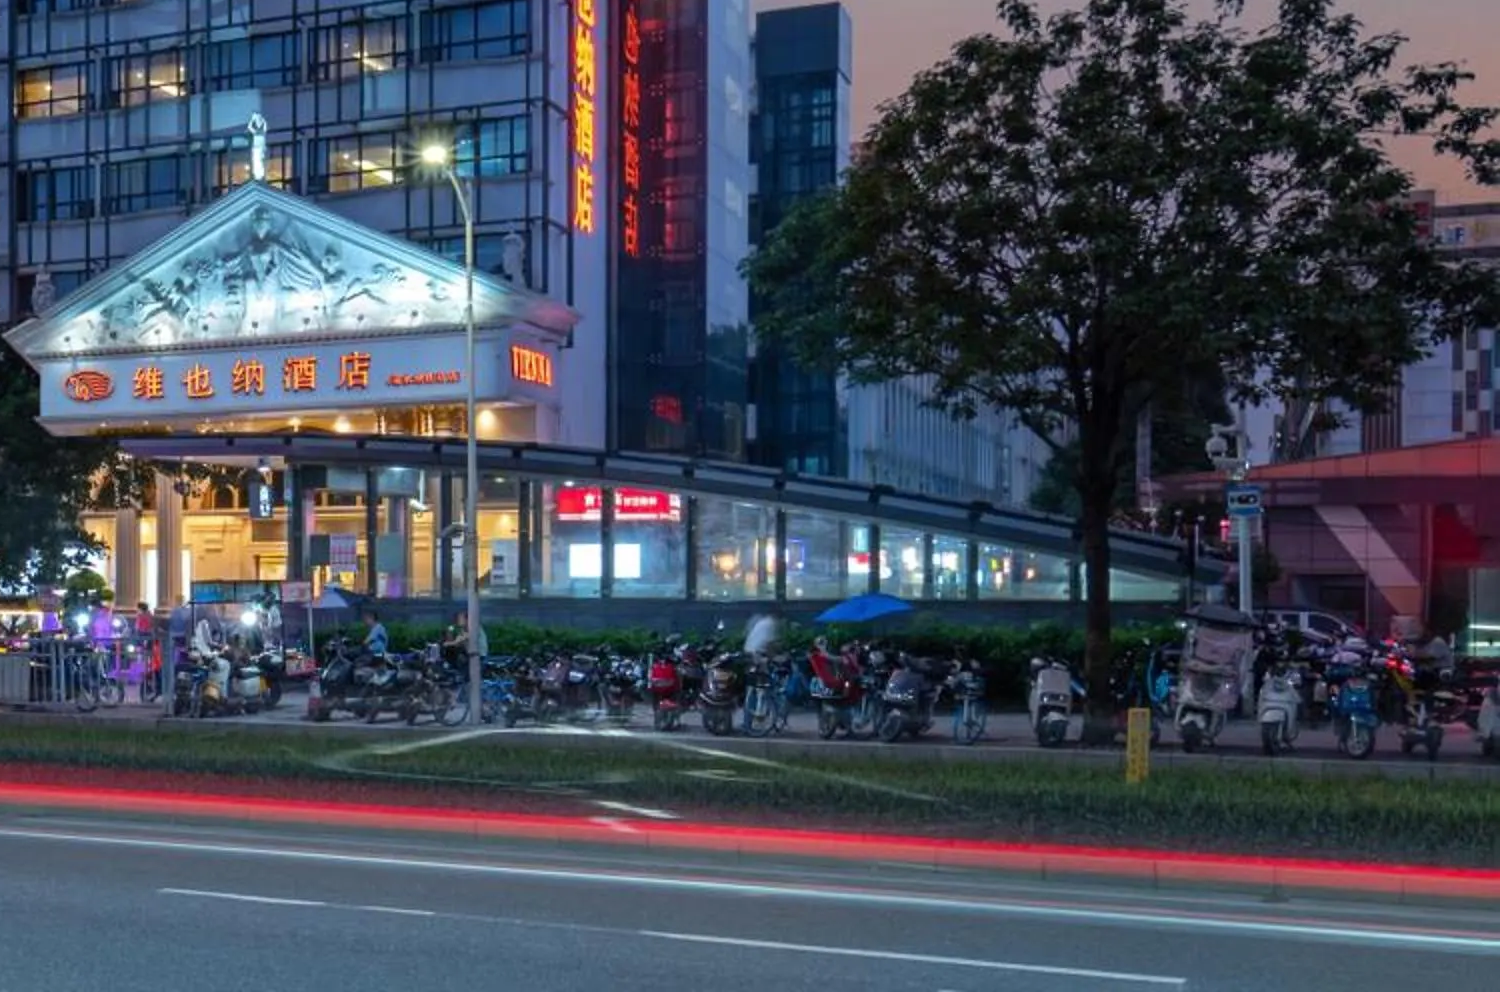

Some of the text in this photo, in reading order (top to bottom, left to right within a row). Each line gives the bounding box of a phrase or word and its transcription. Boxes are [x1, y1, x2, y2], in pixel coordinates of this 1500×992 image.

[133, 352, 371, 399] 维也纳酒店
